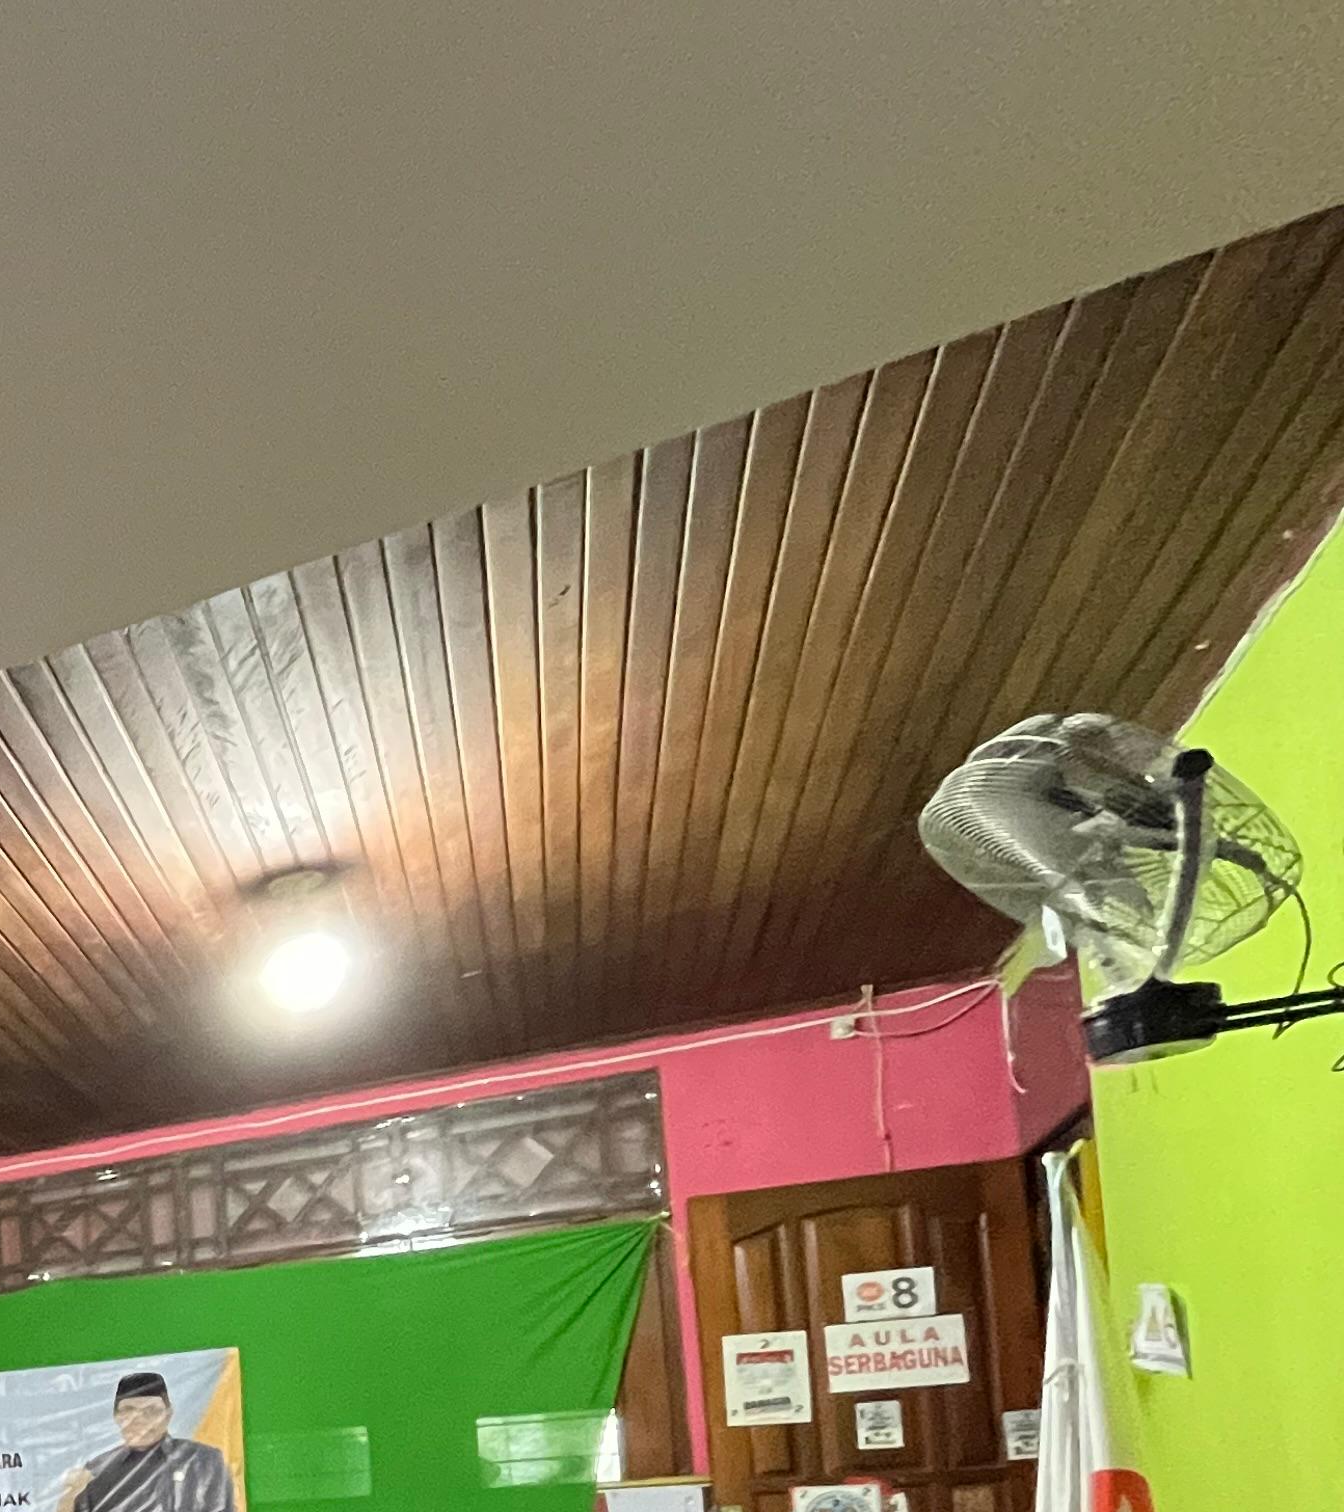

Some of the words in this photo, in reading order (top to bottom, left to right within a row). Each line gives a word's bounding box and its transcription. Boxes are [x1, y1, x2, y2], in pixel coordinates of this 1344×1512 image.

[892, 1276, 918, 1309] 8
[849, 1326, 940, 1348] AULA
[829, 1345, 964, 1376] SERBAGUNA
